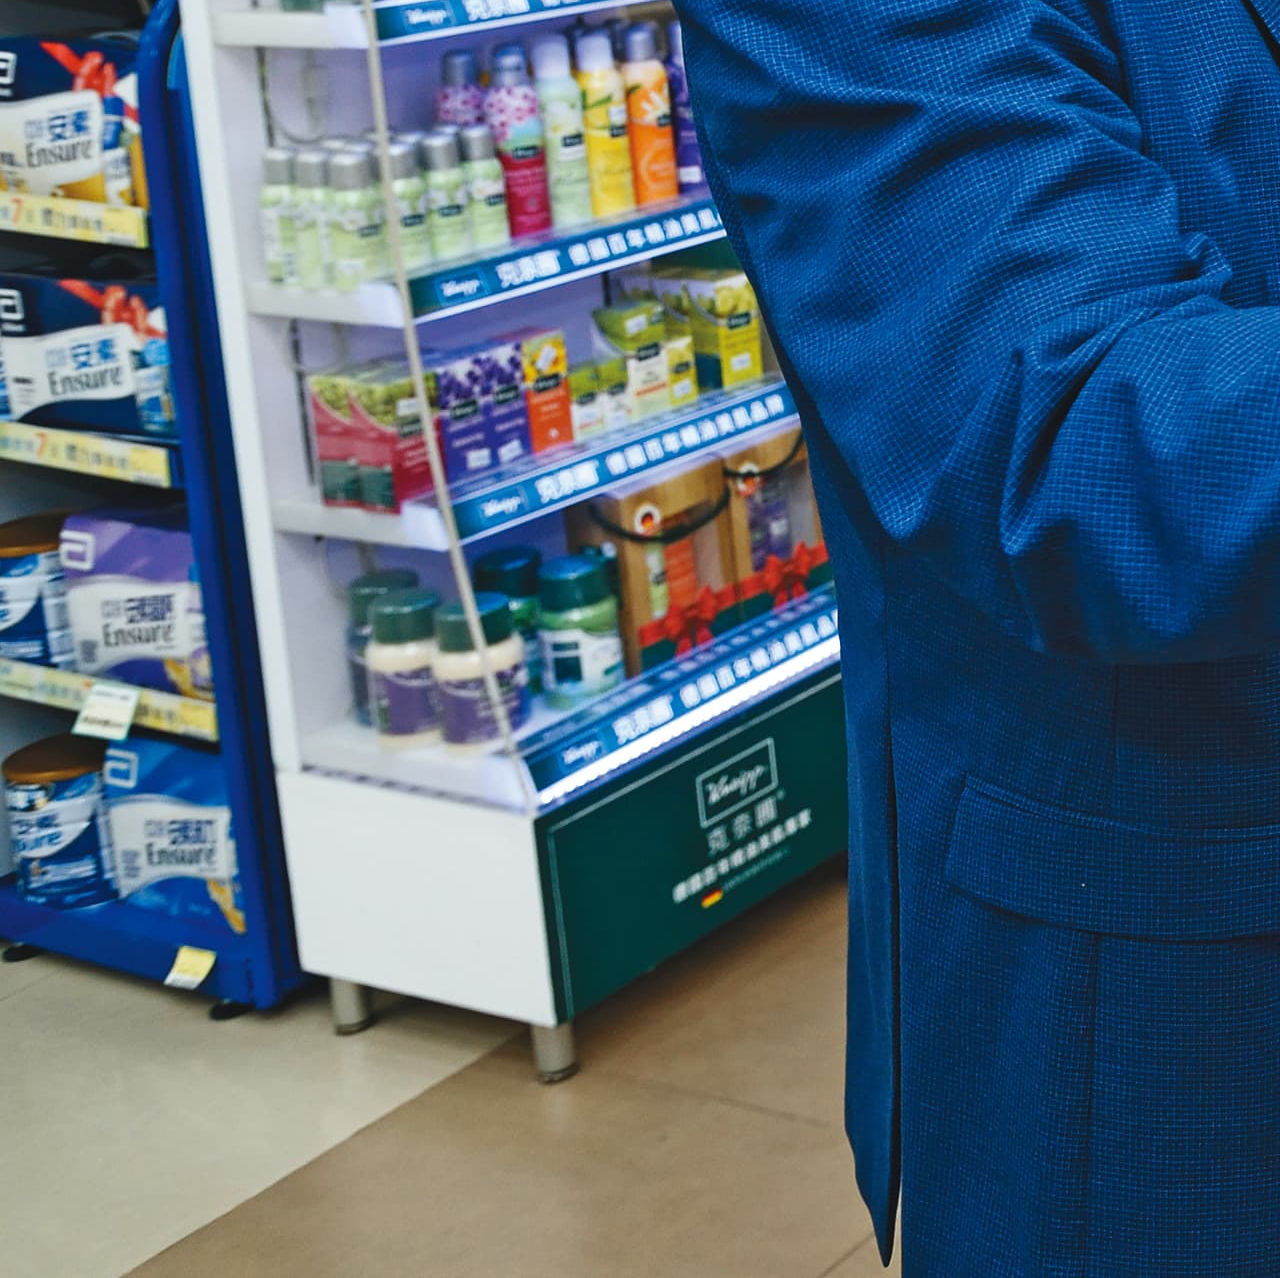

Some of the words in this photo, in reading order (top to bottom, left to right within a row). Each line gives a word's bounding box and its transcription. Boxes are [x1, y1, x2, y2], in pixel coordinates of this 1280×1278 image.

[26, 139, 93, 168] Ensure
[48, 367, 122, 396] Ensure
[102, 623, 173, 648] Ensure
[146, 843, 216, 866] Ensure
